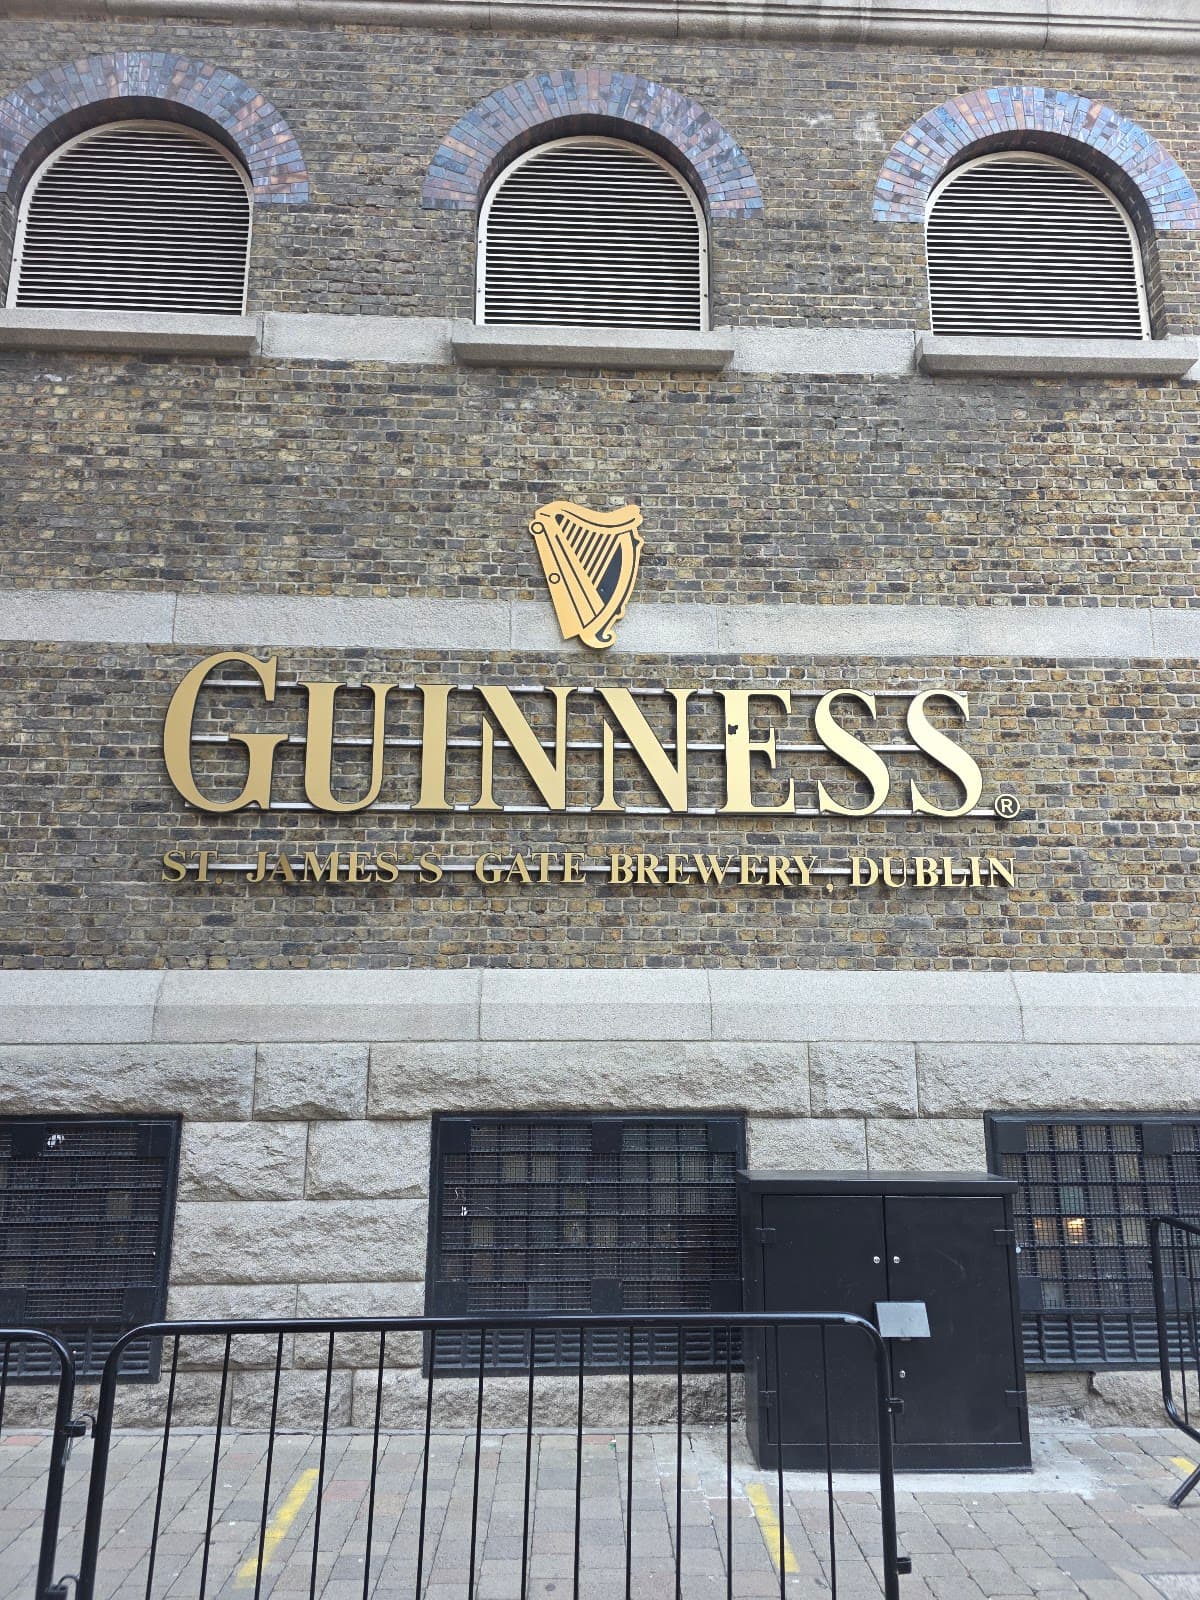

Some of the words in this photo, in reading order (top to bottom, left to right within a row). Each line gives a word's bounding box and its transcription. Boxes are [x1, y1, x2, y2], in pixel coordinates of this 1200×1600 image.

[162, 850, 224, 884] ST.
[246, 851, 442, 883] JAMES'S
[475, 852, 586, 884] GATE
[608, 853, 834, 892] BREWERY,
[849, 856, 1016, 888] DUBLIN
